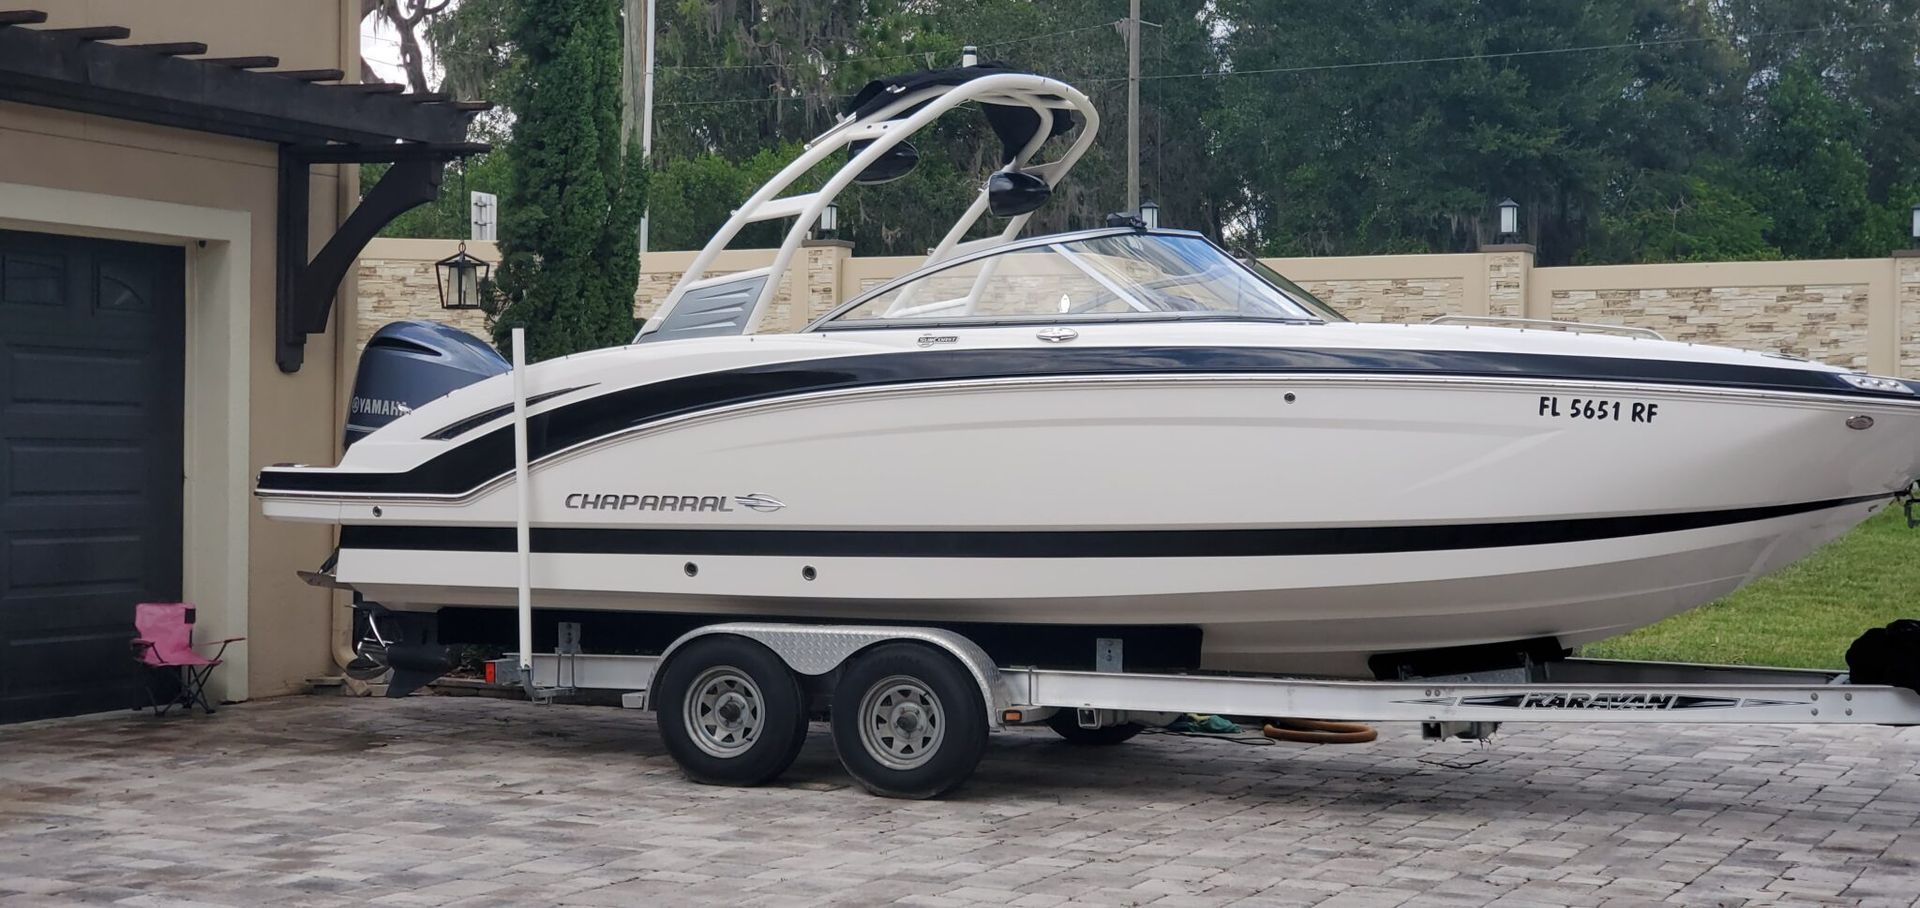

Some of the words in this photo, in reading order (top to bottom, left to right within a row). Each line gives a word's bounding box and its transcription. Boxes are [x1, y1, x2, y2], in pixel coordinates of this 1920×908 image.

[359, 398, 405, 416] YAMAH
[1539, 396, 1561, 417] FL
[1570, 398, 1621, 421] 5651
[1631, 402, 1658, 423] RF
[565, 493, 734, 512] CHAPARRAL
[1521, 692, 1676, 710] KARAVAN
